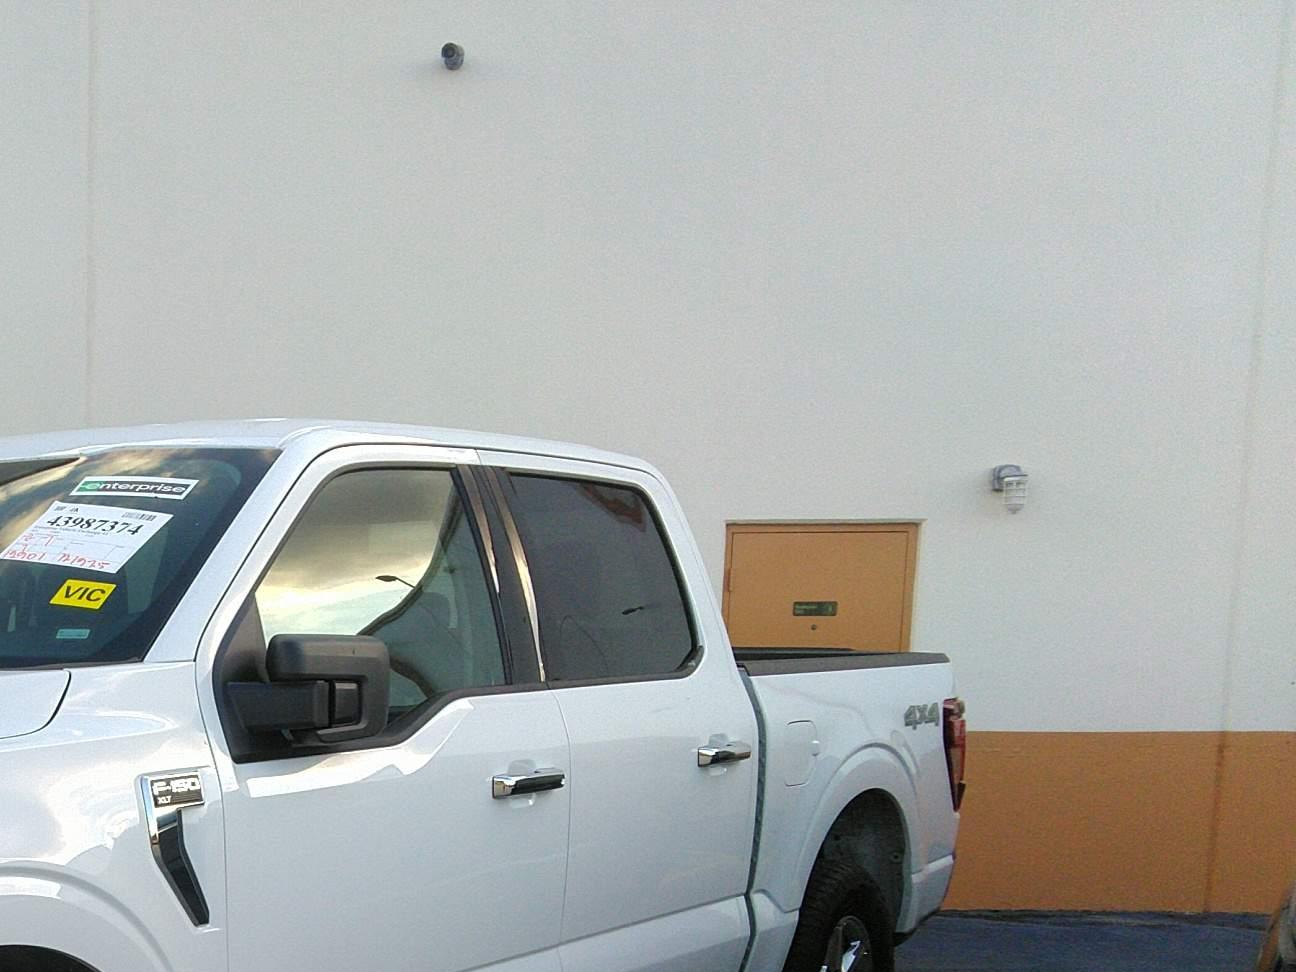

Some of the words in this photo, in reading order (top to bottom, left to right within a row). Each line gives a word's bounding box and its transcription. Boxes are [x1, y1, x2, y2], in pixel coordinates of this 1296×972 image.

[81, 482, 186, 494] enterprise
[47, 515, 144, 535] 43987374
[64, 586, 106, 602] VIC
[152, 777, 201, 795] F-150
[156, 795, 172, 805] XLT
